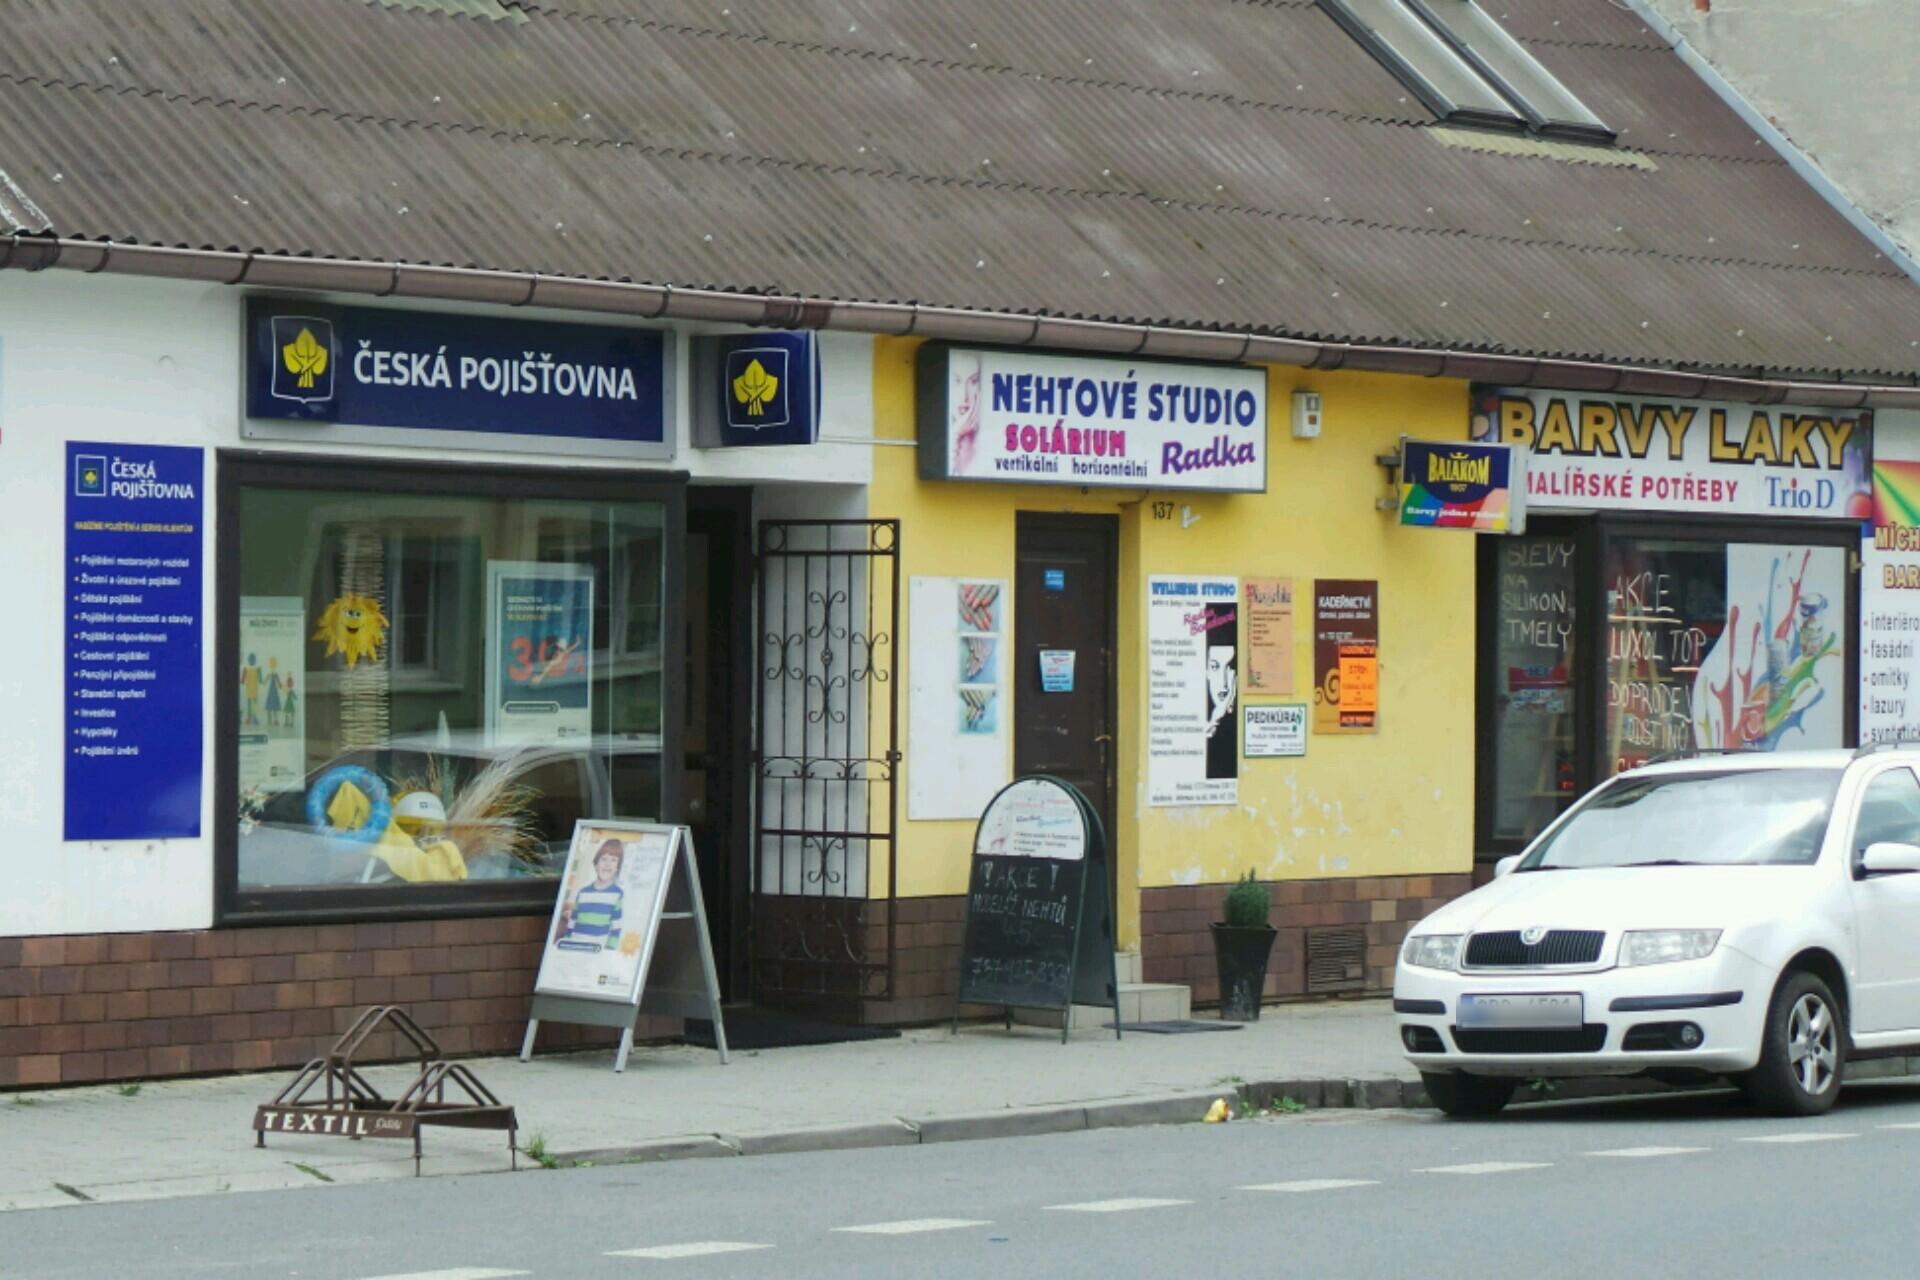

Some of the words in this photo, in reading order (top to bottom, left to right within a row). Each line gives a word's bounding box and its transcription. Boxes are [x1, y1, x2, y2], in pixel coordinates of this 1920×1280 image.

[353, 339, 452, 389] ČESKÁ
[460, 351, 638, 400] POJIŠŤOVNA
[992, 369, 1138, 420] NEHTOVÉ
[1148, 383, 1257, 427] STUDIO
[1005, 419, 1126, 457] SOLÁRIUM
[1498, 393, 1699, 462] BARVY
[1709, 408, 1857, 470] LAKY
[994, 455, 1059, 474] vertikální
[1161, 434, 1256, 476] Radka
[110, 456, 156, 479] ČESKÁ
[111, 479, 194, 499] POJIŠŤOVNA
[1641, 472, 1738, 502] POTŘEBY
[1152, 501, 1175, 520] 137
[1406, 506, 1437, 517] Barvy
[81, 555, 115, 567] Pojištění
[1507, 543, 1576, 568] SLEVY
[81, 572, 108, 584] Životní
[1503, 573, 1528, 589] NA
[109, 594, 142, 605] pojištění
[1318, 594, 1371, 609] KADEŘNICTVÍ
[1614, 572, 1675, 613] AKCE
[81, 612, 114, 623] Pojištění
[81, 631, 114, 642] Pojištění
[1506, 619, 1572, 653] TMELY
[1609, 626, 1664, 661] LUXOL
[1669, 627, 1708, 663] TOP
[117, 651, 150, 662] pojištění
[1871, 639, 1914, 659] fasádní
[1871, 667, 1910, 691] omítky
[1871, 695, 1906, 718] lazury
[81, 745, 115, 757] Pojištění
[263, 1111, 368, 1136] TEXTIL
